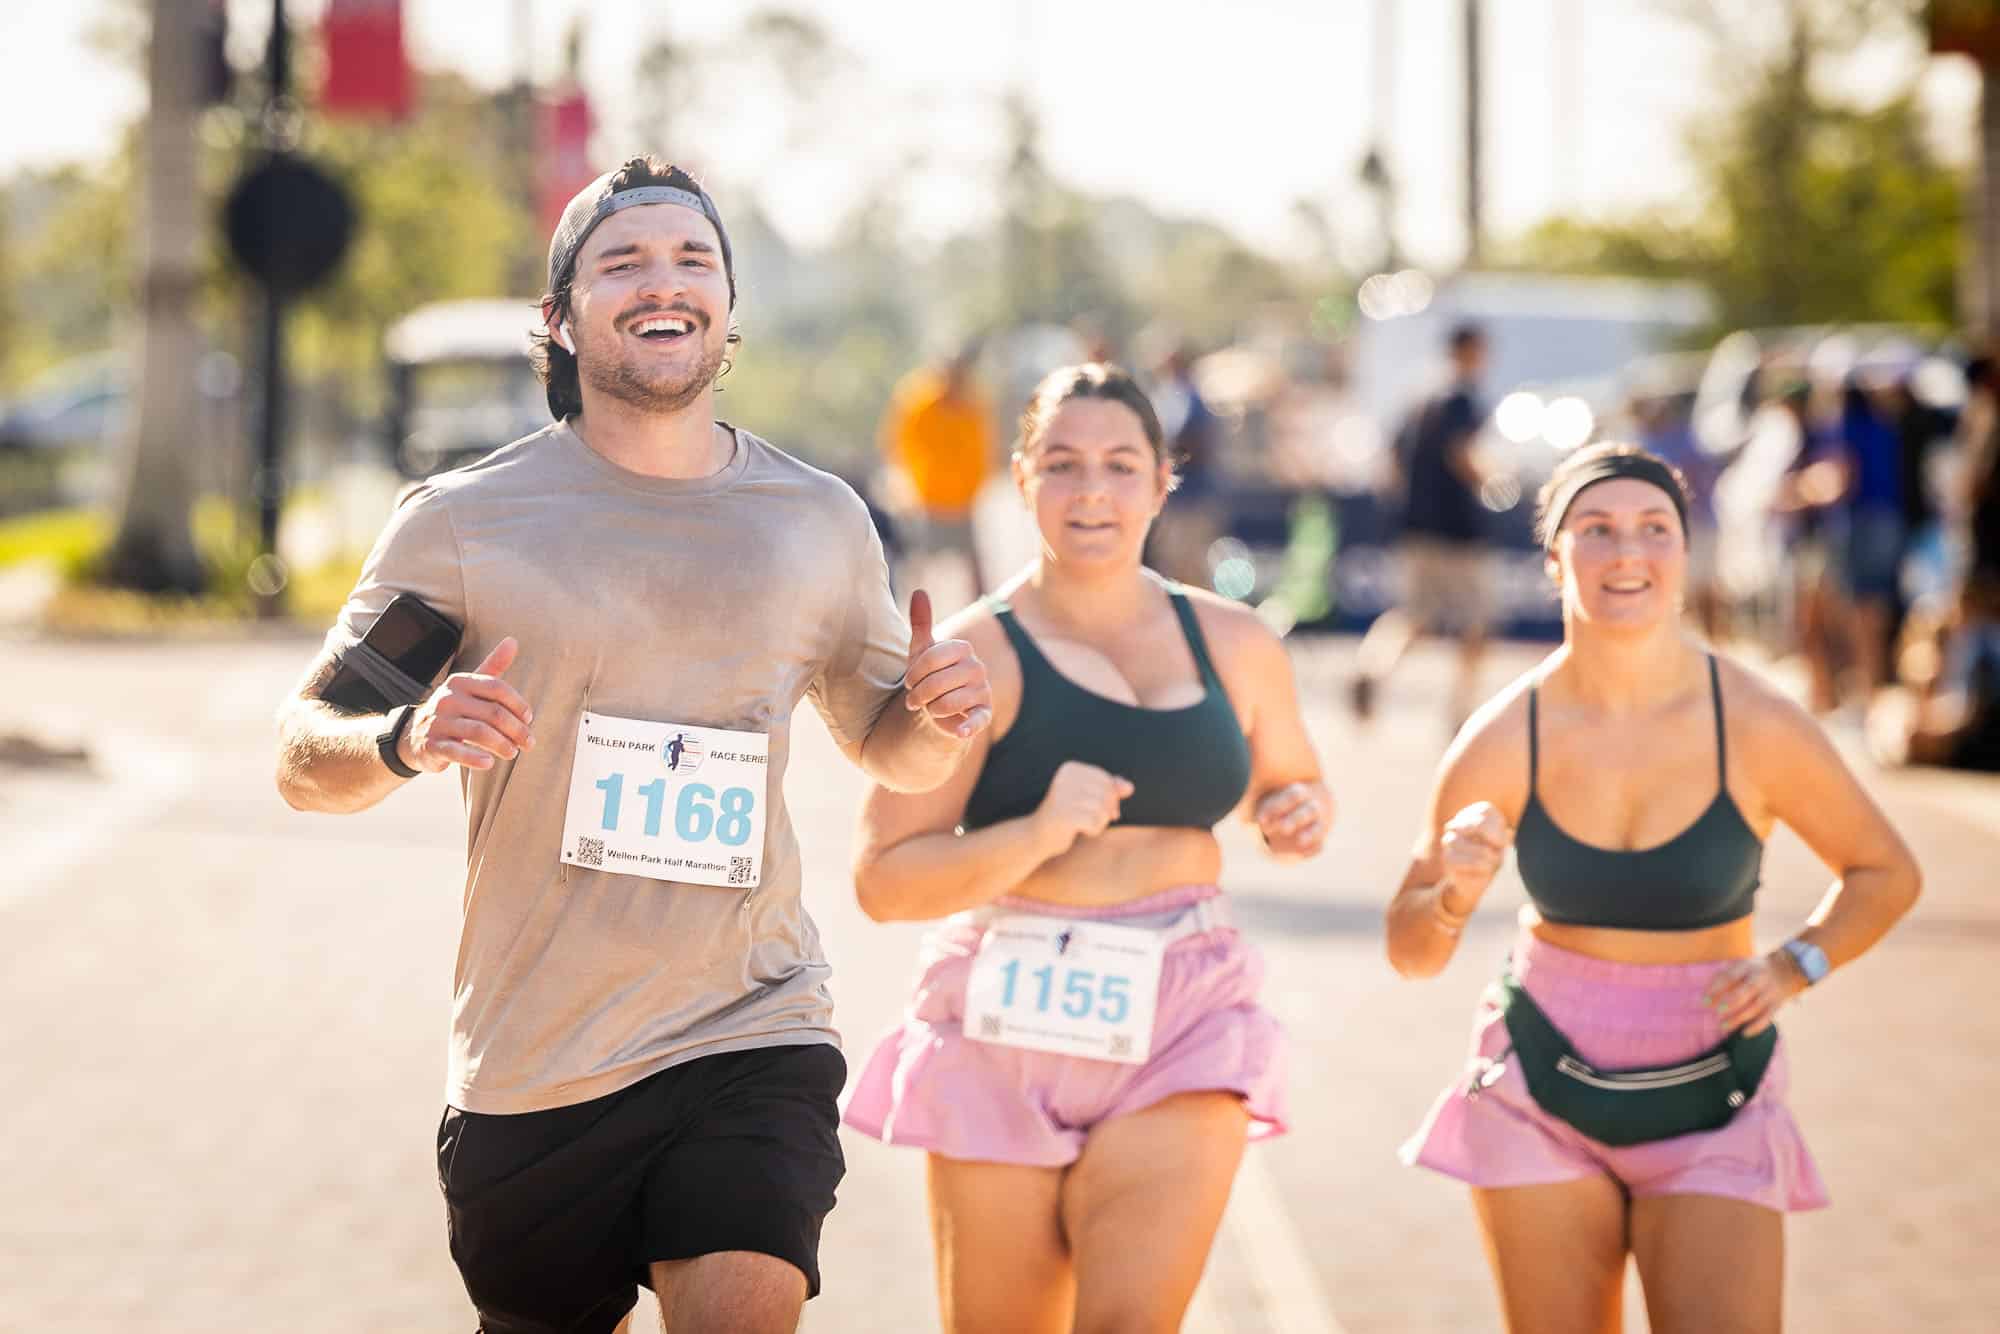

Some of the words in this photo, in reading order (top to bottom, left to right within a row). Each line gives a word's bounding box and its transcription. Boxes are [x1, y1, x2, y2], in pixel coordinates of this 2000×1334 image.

[587, 735, 626, 749] WELLEN
[628, 742, 656, 752] PARK
[710, 751, 737, 761] RACE
[595, 772, 754, 846] 1168
[607, 849, 638, 861] Wellen
[640, 854, 662, 865] Park
[664, 857, 683, 868] Half
[685, 859, 727, 871] Marathon
[1000, 959, 1131, 1024] 1155
